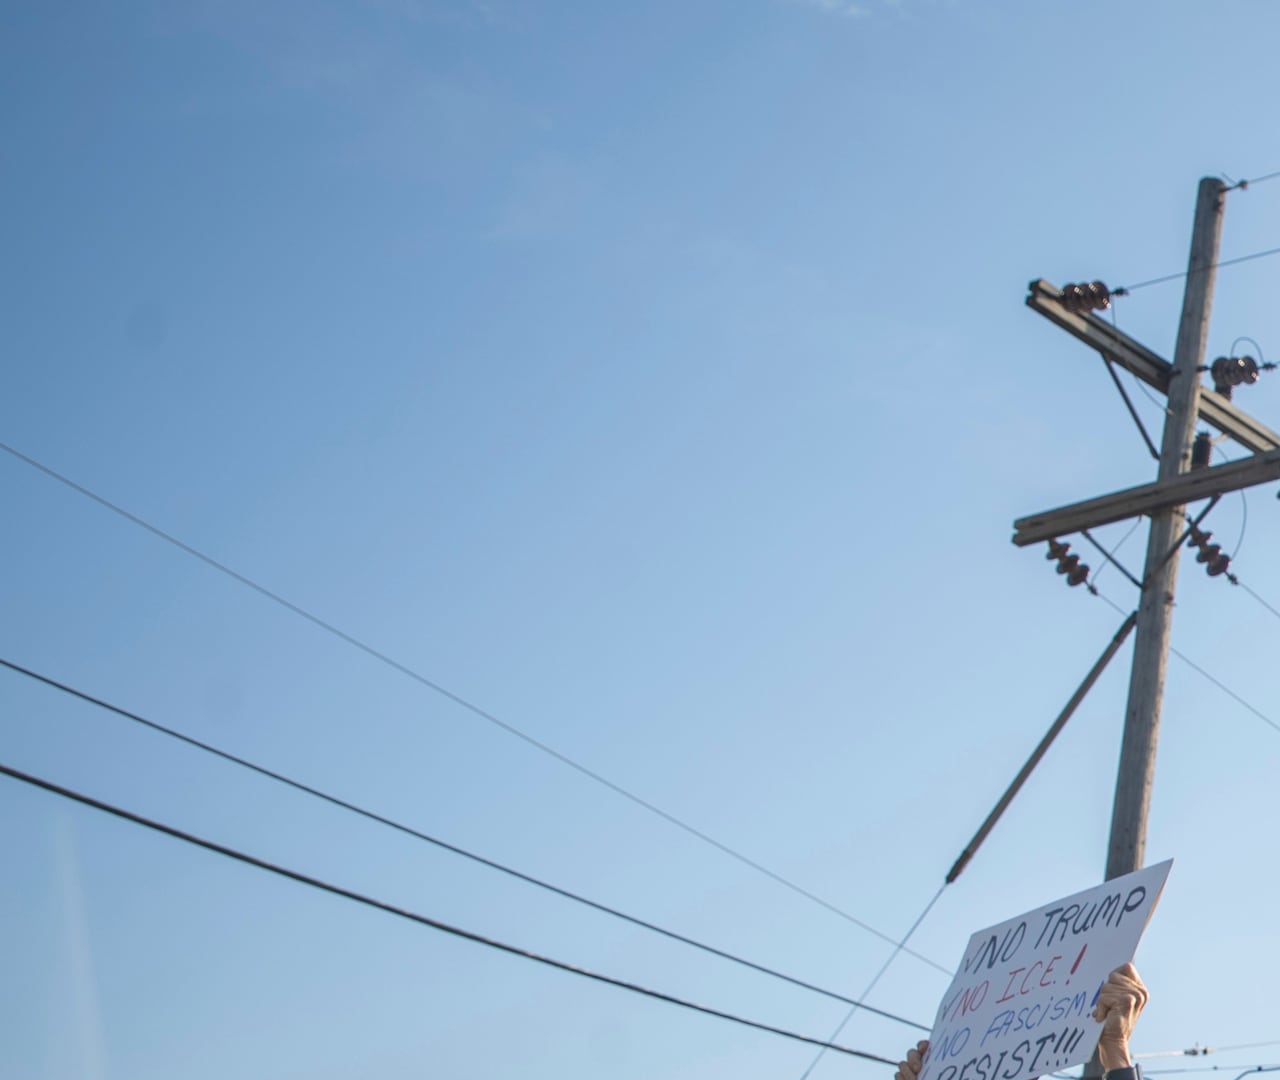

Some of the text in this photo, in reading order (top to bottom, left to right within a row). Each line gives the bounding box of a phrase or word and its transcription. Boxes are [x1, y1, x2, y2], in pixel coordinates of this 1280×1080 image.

[973, 886, 1147, 975] NO TRUMP
[950, 980, 990, 1023] NO
[934, 1027, 971, 1063] NO
